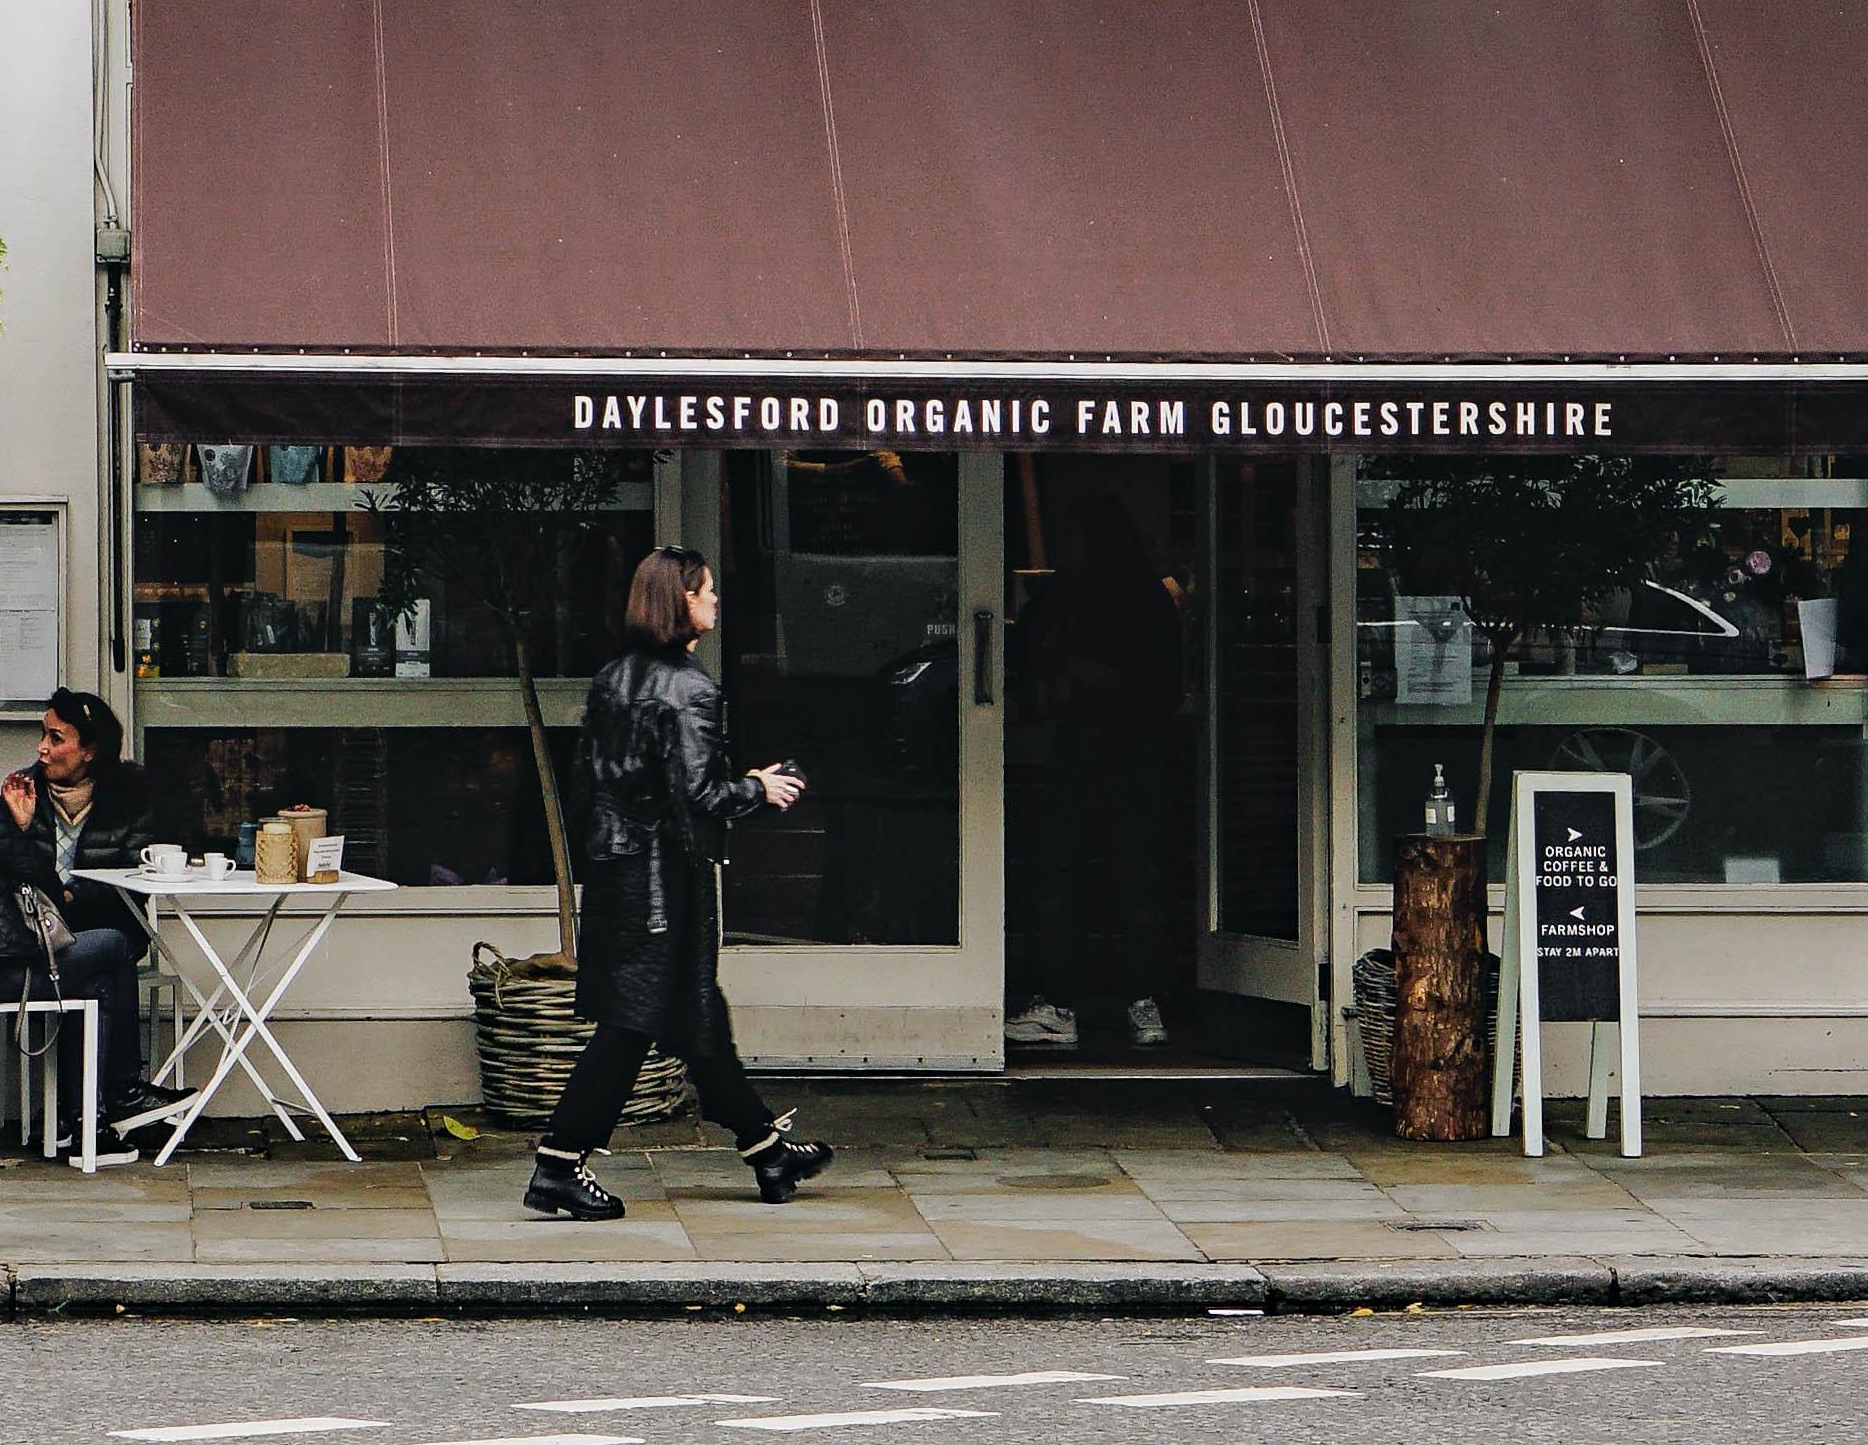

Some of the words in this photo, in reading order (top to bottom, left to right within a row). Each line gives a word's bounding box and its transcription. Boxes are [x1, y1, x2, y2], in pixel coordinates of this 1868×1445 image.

[574, 395, 839, 432] DAYLESFORD
[866, 398, 1050, 434] ORGANIC
[1078, 400, 1184, 435] FARM
[1211, 401, 1612, 436] GLOUCESTERSHIRE
[926, 623, 957, 635] PUSH
[1545, 845, 1606, 858] ORGANIC
[1543, 860, 1595, 873] COFFEE
[1598, 860, 1609, 873] &
[1536, 875, 1572, 887] FOOD
[1576, 875, 1594, 887] TO
[1598, 875, 1618, 887] GO
[1541, 924, 1615, 937] FARMSHOP
[1537, 946, 1562, 958] STAY
[1565, 946, 1582, 958] 2M
[1585, 946, 1619, 957] APART
